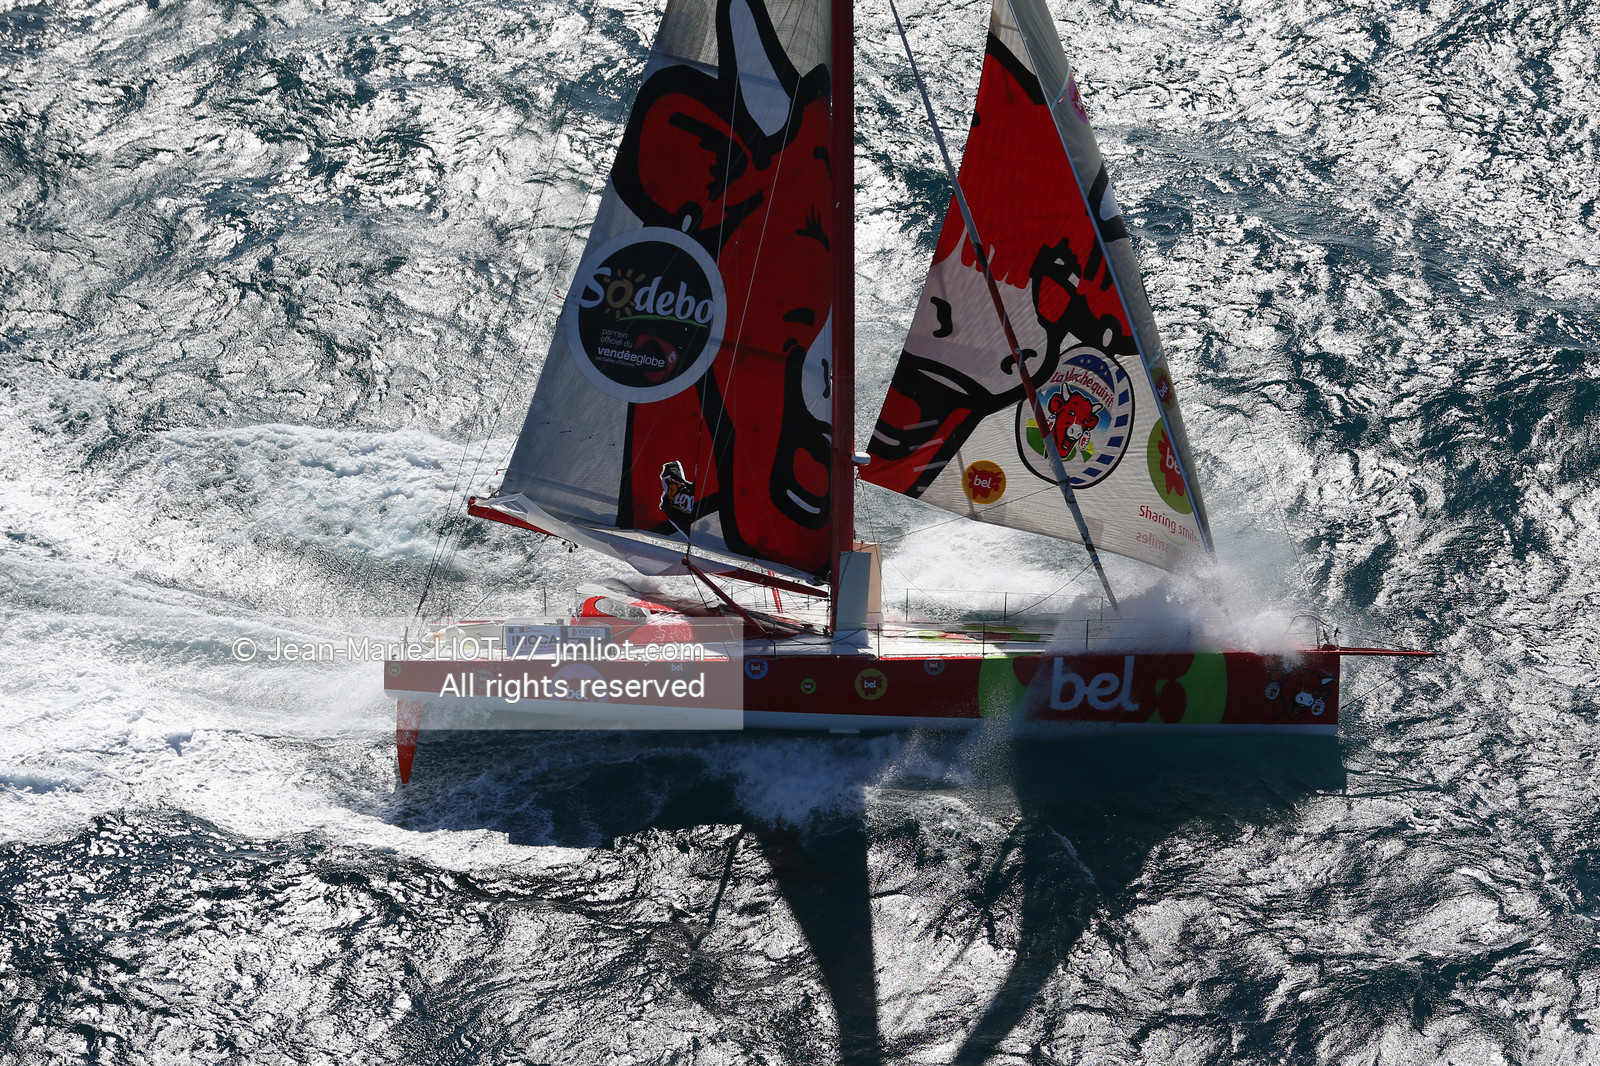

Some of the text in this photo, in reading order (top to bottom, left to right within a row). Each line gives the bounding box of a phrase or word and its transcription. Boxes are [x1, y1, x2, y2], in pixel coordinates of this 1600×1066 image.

[579, 267, 715, 324] Sodebo
[601, 328, 629, 339] parrain
[600, 336, 634, 349] officiel du
[1157, 382, 1169, 398] bel
[1165, 446, 1181, 475] be
[973, 474, 992, 489] bel
[1139, 505, 1177, 534] Sharing
[671, 663, 684, 671] bel
[750, 663, 761, 671] bel
[929, 661, 938, 669] bel
[863, 679, 877, 690] bel
[1050, 655, 1140, 711] bel
